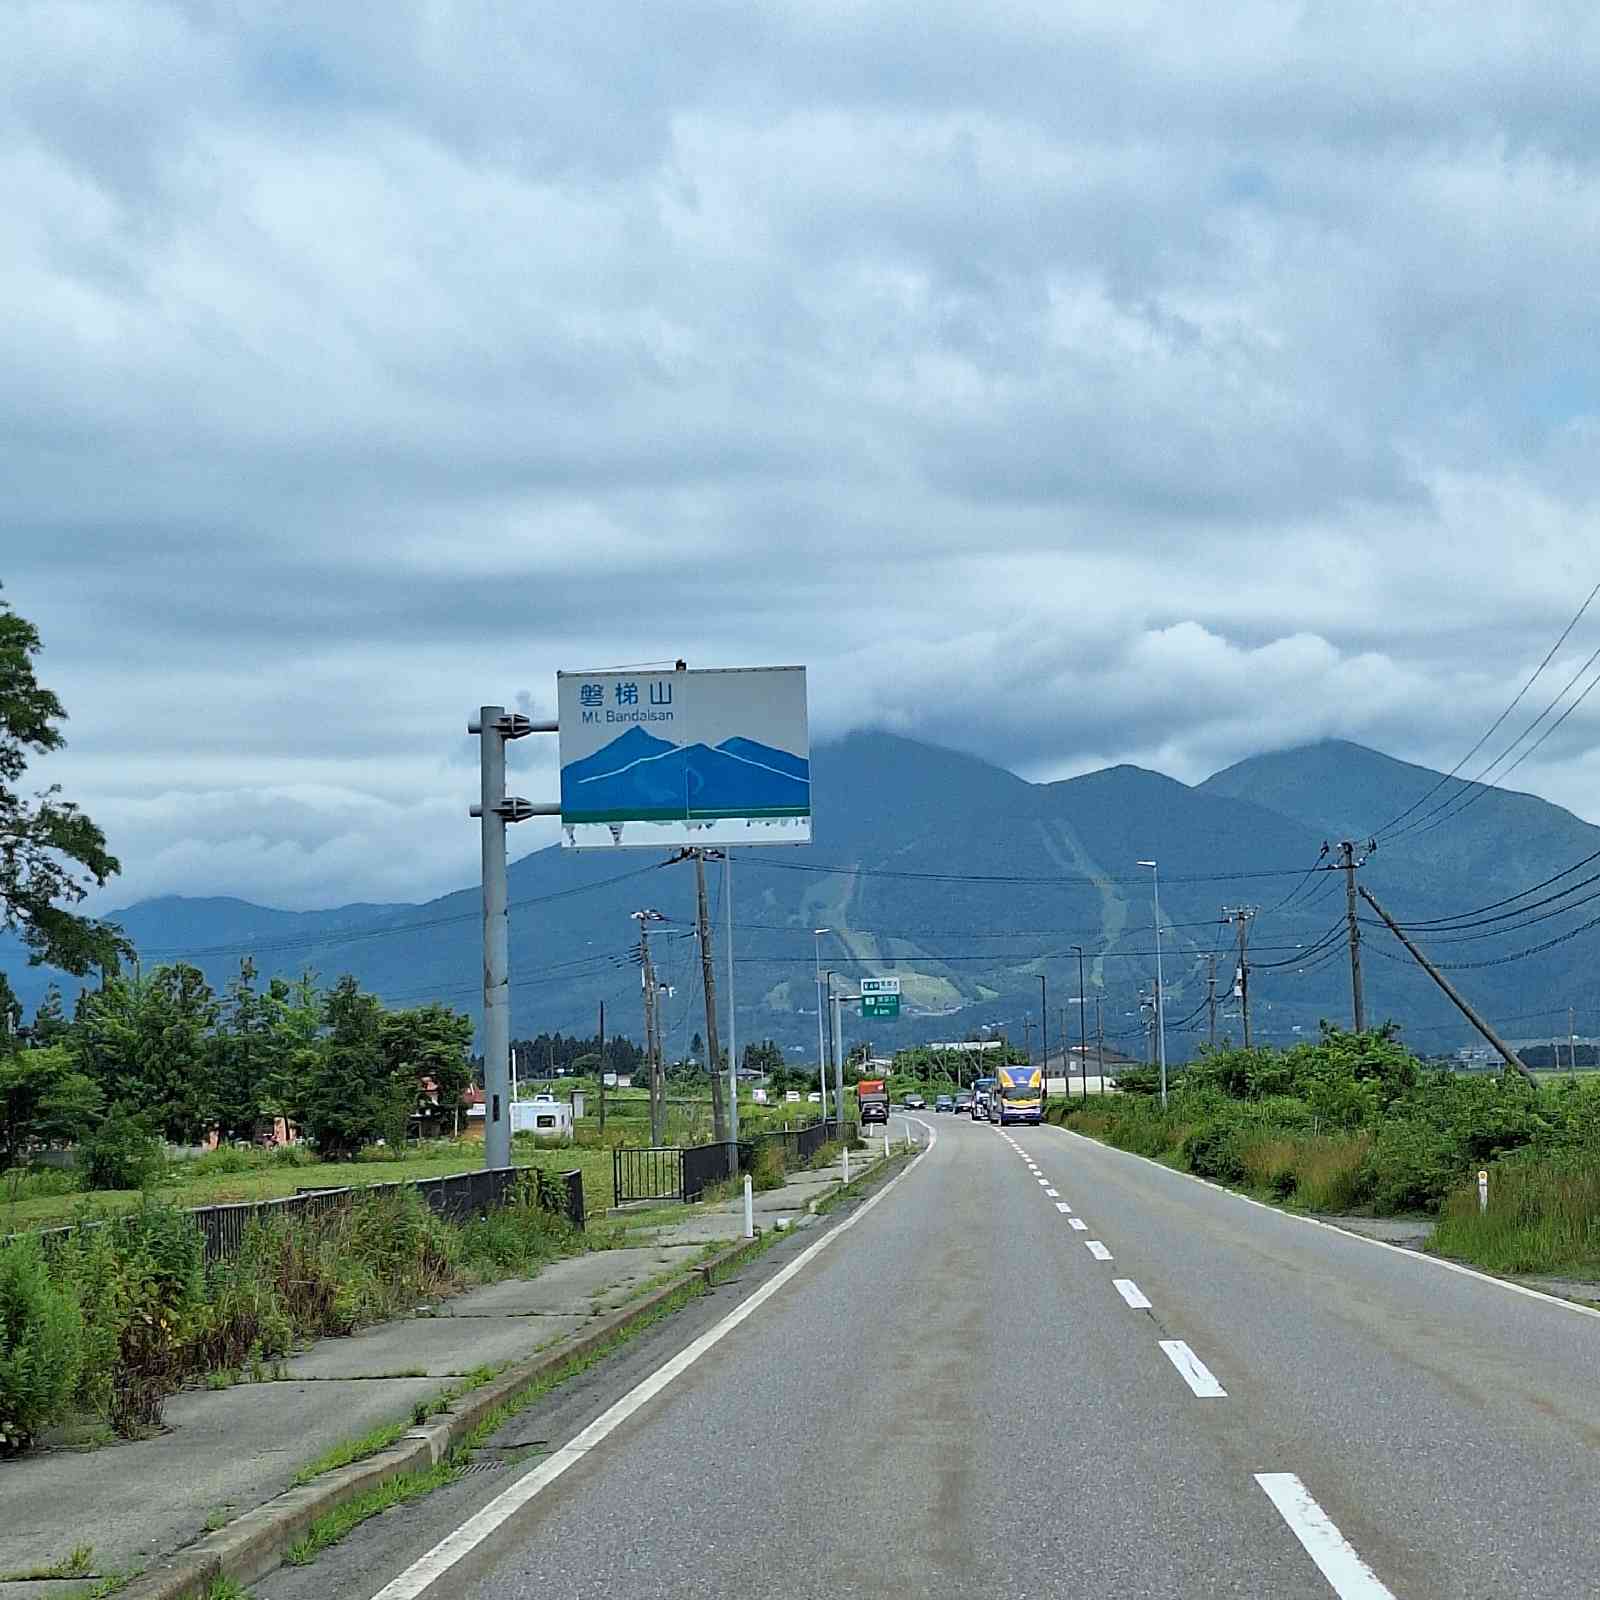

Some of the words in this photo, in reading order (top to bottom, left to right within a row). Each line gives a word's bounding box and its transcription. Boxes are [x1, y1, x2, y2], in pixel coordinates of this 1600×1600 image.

[580, 681, 672, 706] 磐梯山
[606, 709, 674, 722] Bandaisan
